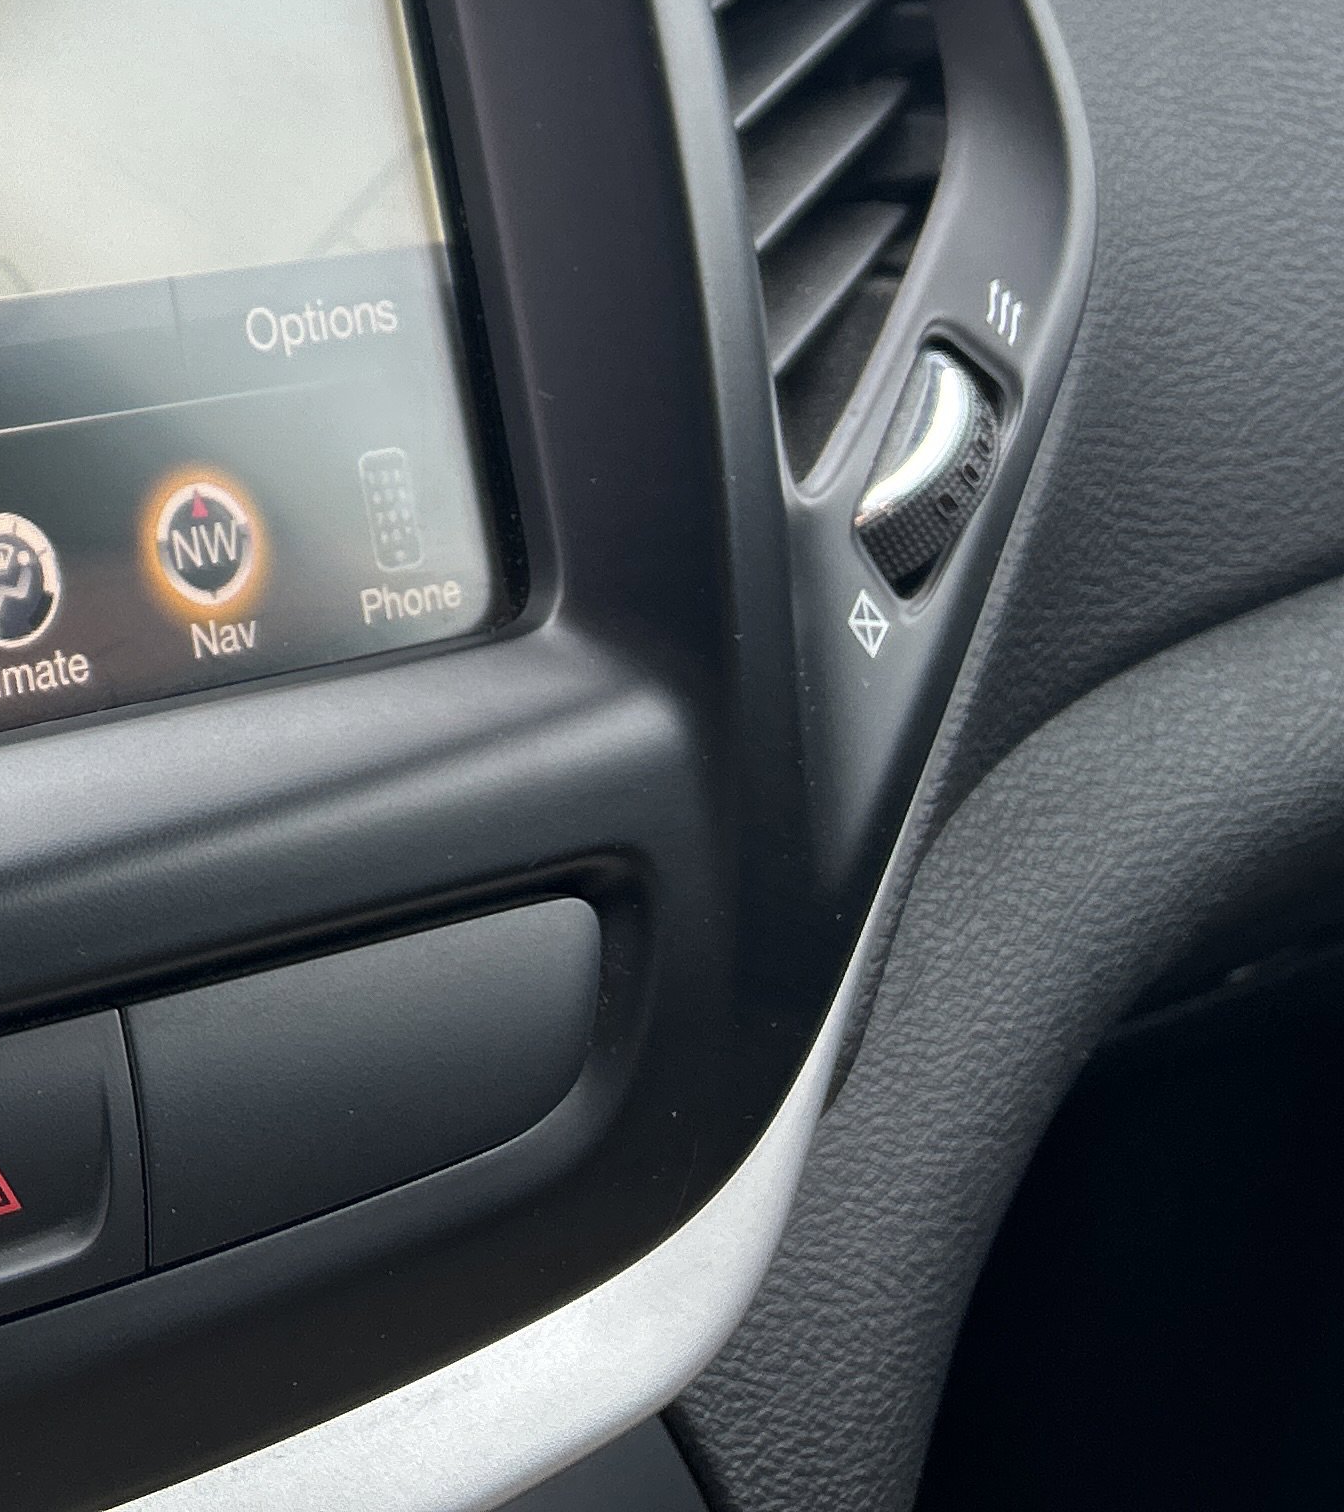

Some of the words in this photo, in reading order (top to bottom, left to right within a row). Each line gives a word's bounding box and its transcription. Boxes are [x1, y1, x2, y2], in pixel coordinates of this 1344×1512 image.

[246, 298, 400, 358] Options
[171, 521, 240, 572] NW
[360, 580, 463, 626] Phone
[190, 621, 259, 659] Nav
